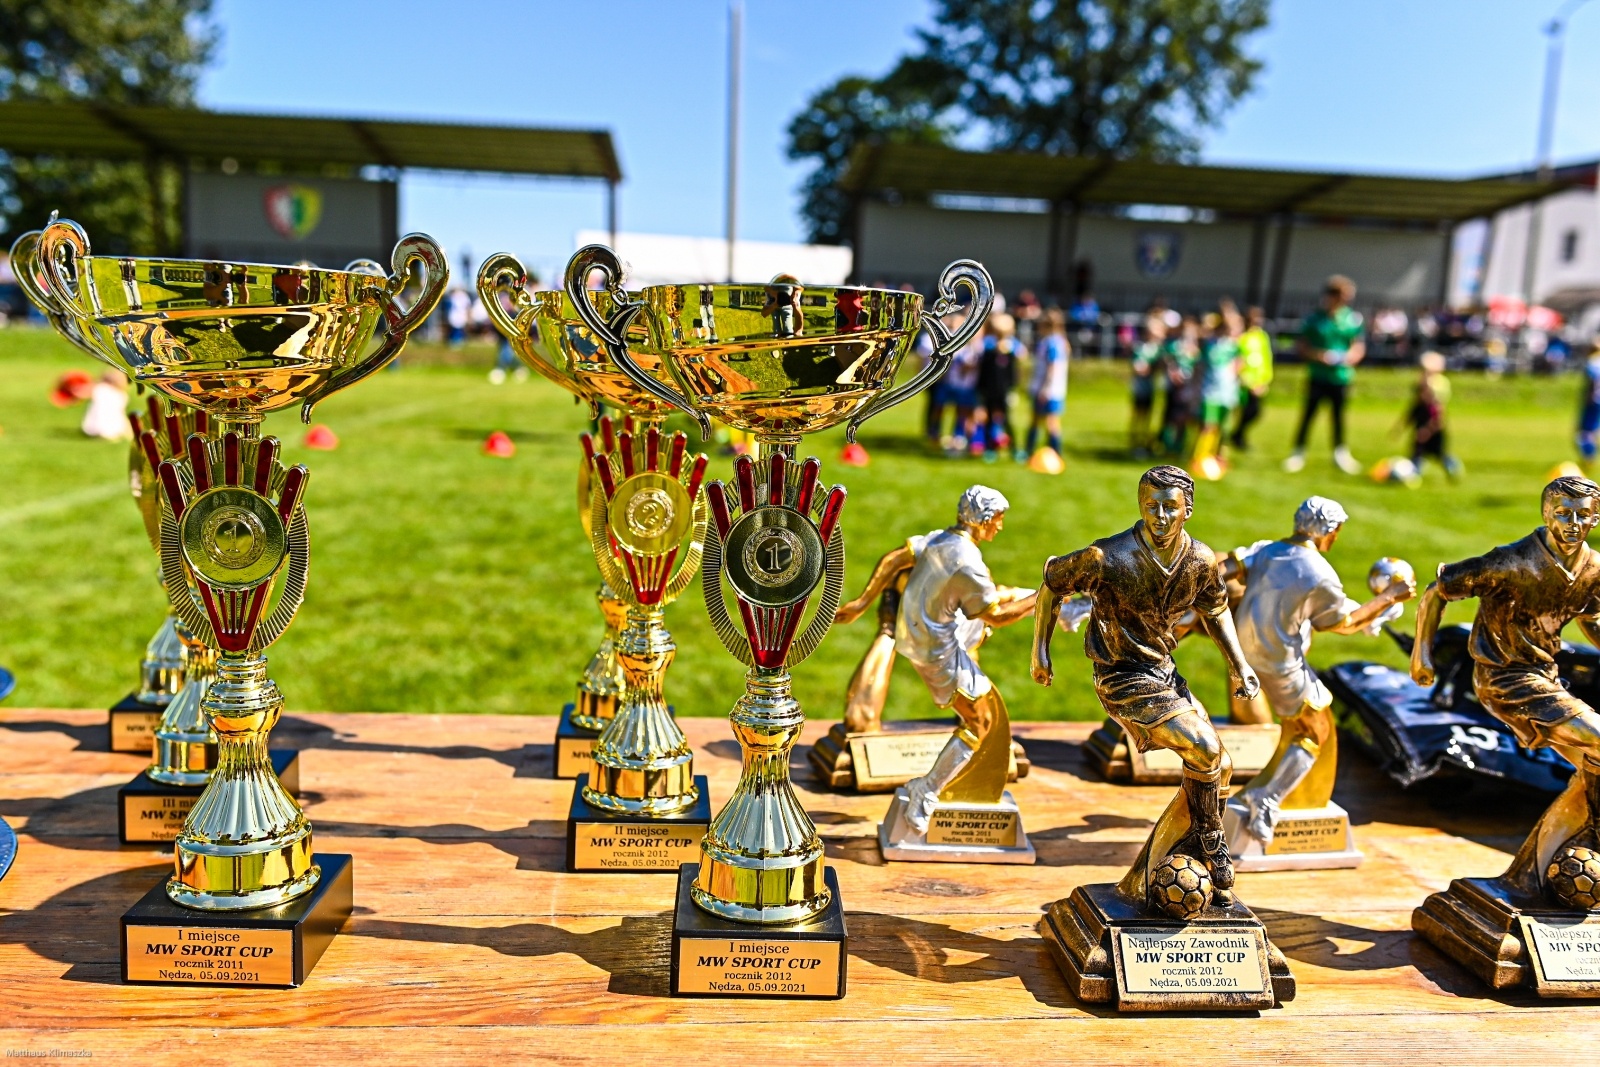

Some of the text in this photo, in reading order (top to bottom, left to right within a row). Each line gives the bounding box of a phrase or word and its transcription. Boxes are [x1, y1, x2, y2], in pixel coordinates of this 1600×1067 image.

[223, 525, 241, 553] 1
[765, 542, 782, 570] 1
[140, 810, 166, 819] MW
[935, 820, 1009, 830] MW SPORT CUP
[615, 825, 669, 837] II miejsce
[1321, 828, 1340, 836] CUP
[590, 838, 692, 848] MW SPORT CUP
[613, 850, 669, 858] rocznik 2012
[633, 859, 680, 867] 05.09.2021
[178, 929, 240, 943] I miejsce
[1539, 927, 1593, 941] Najlepszy
[729, 942, 790, 956] I miejsce
[1128, 937, 1250, 950] Najlepszy Zawodnik
[1549, 942, 1573, 952] MW
[145, 944, 273, 958] MW SPORT CUP
[697, 956, 821, 970] MW SPORT CUP
[1136, 952, 1246, 963] MW SPORT CUP
[174, 959, 243, 969] rocznik 2011
[159, 969, 259, 981] Nędza, 05.09.2021
[724, 971, 792, 980] rocznik 2012
[1162, 966, 1223, 976] rocznik 2012
[708, 981, 806, 992] Nędza, 05.09.2021
[1150, 977, 1239, 988] Nędza, 05.09.2021
